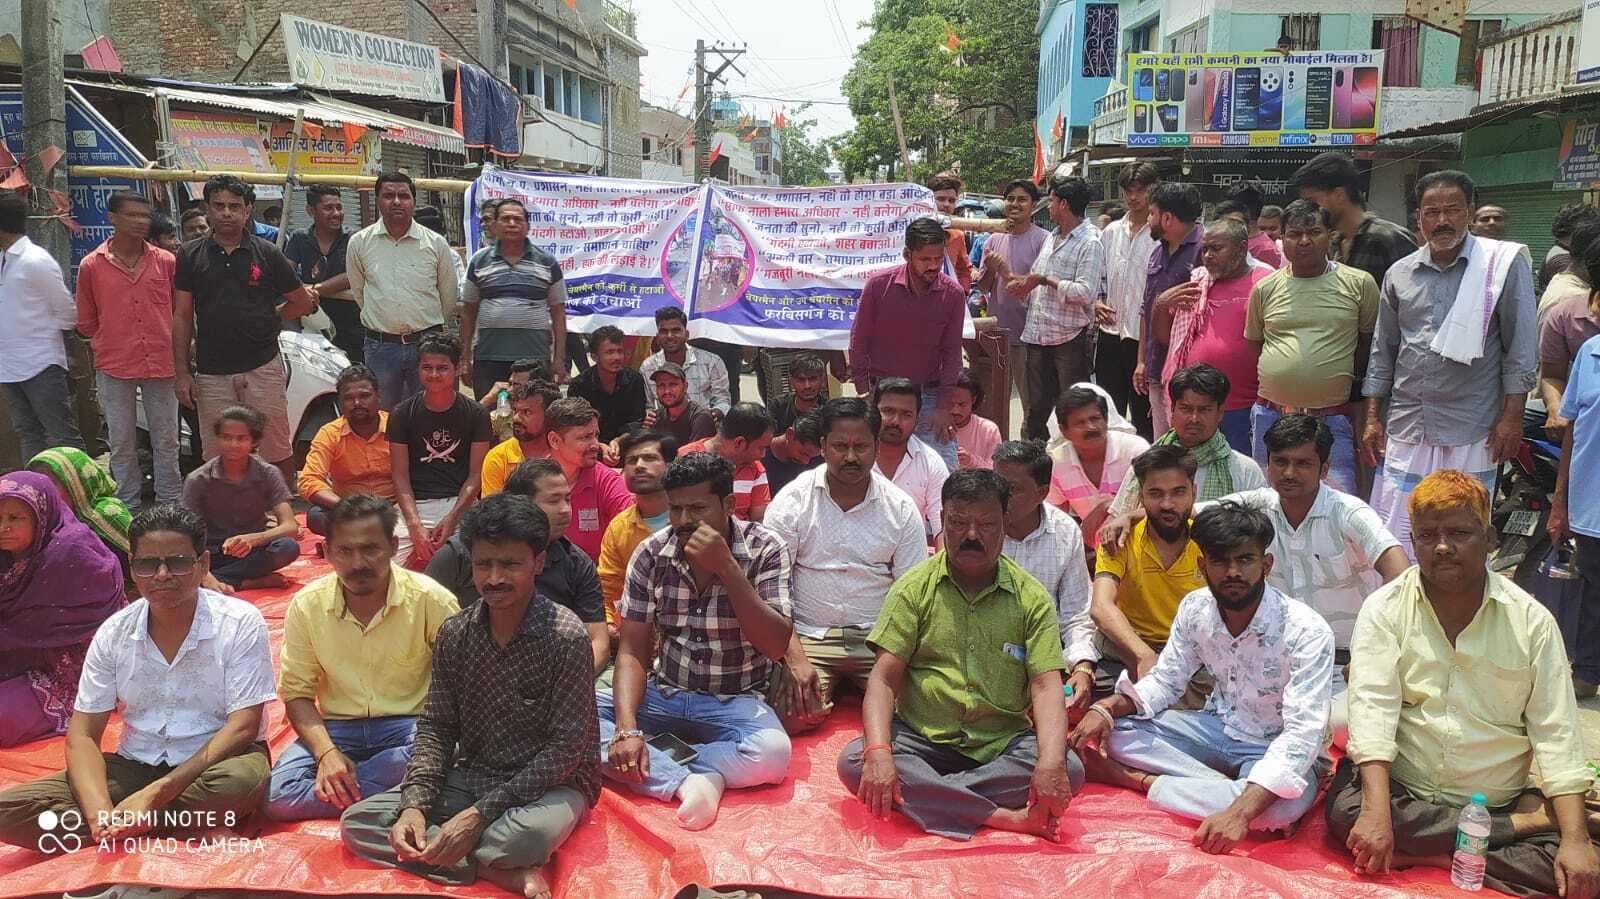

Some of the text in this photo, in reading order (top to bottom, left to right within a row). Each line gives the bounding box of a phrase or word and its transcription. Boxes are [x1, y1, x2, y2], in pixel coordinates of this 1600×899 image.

[294, 20, 436, 70] WOMEN'S COLLECTION
[1129, 135, 1157, 144] vivo
